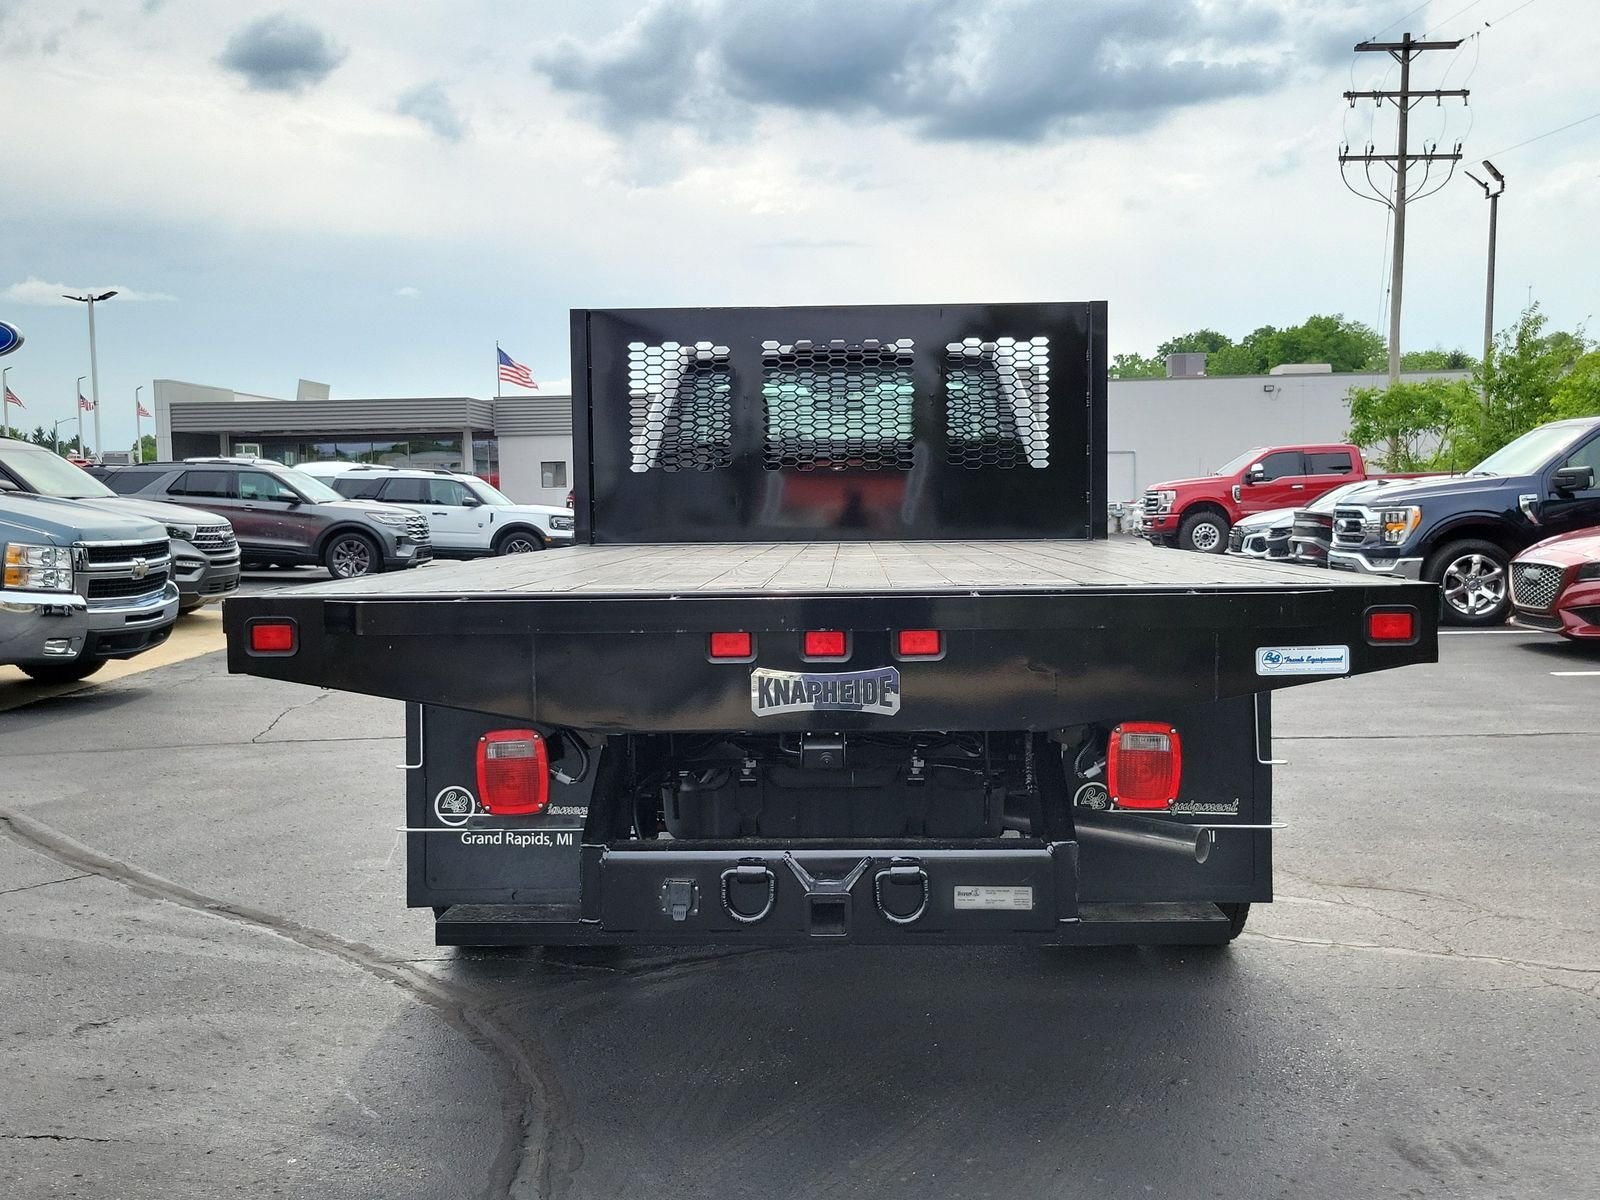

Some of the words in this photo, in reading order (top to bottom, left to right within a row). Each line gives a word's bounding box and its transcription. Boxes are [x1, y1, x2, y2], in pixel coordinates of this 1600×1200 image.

[757, 674, 894, 709] KNAPHEIDE
[1170, 798, 1239, 816] quipment
[461, 831, 502, 845] Grand
[505, 831, 553, 848] Rapids,
[556, 832, 573, 846] MI
